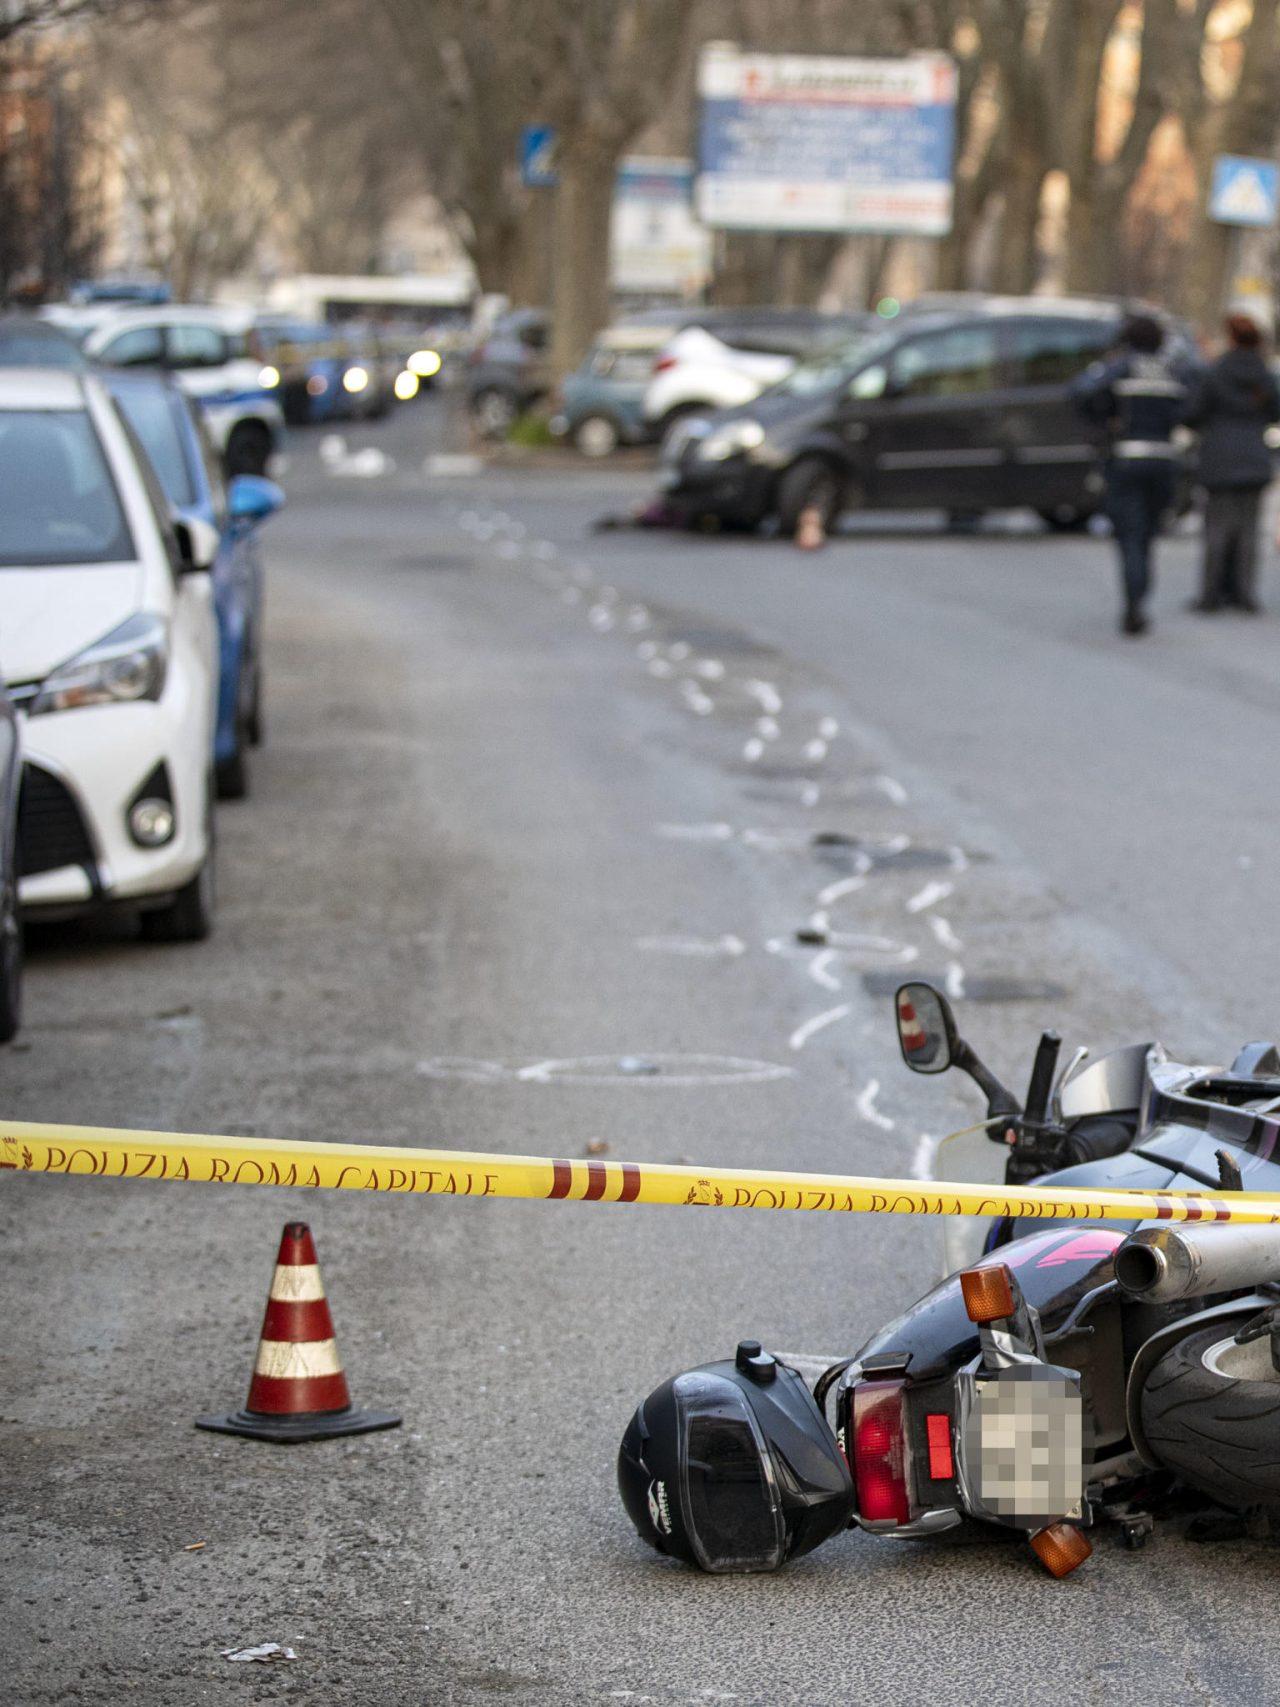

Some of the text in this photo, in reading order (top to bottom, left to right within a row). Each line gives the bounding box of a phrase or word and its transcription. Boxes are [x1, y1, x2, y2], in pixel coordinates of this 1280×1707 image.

[44, 1147, 498, 1196] POLIZIA ROMA CAPITALE
[733, 1188, 854, 1212] POLIZIA
[867, 1194, 962, 1216] ROMA
